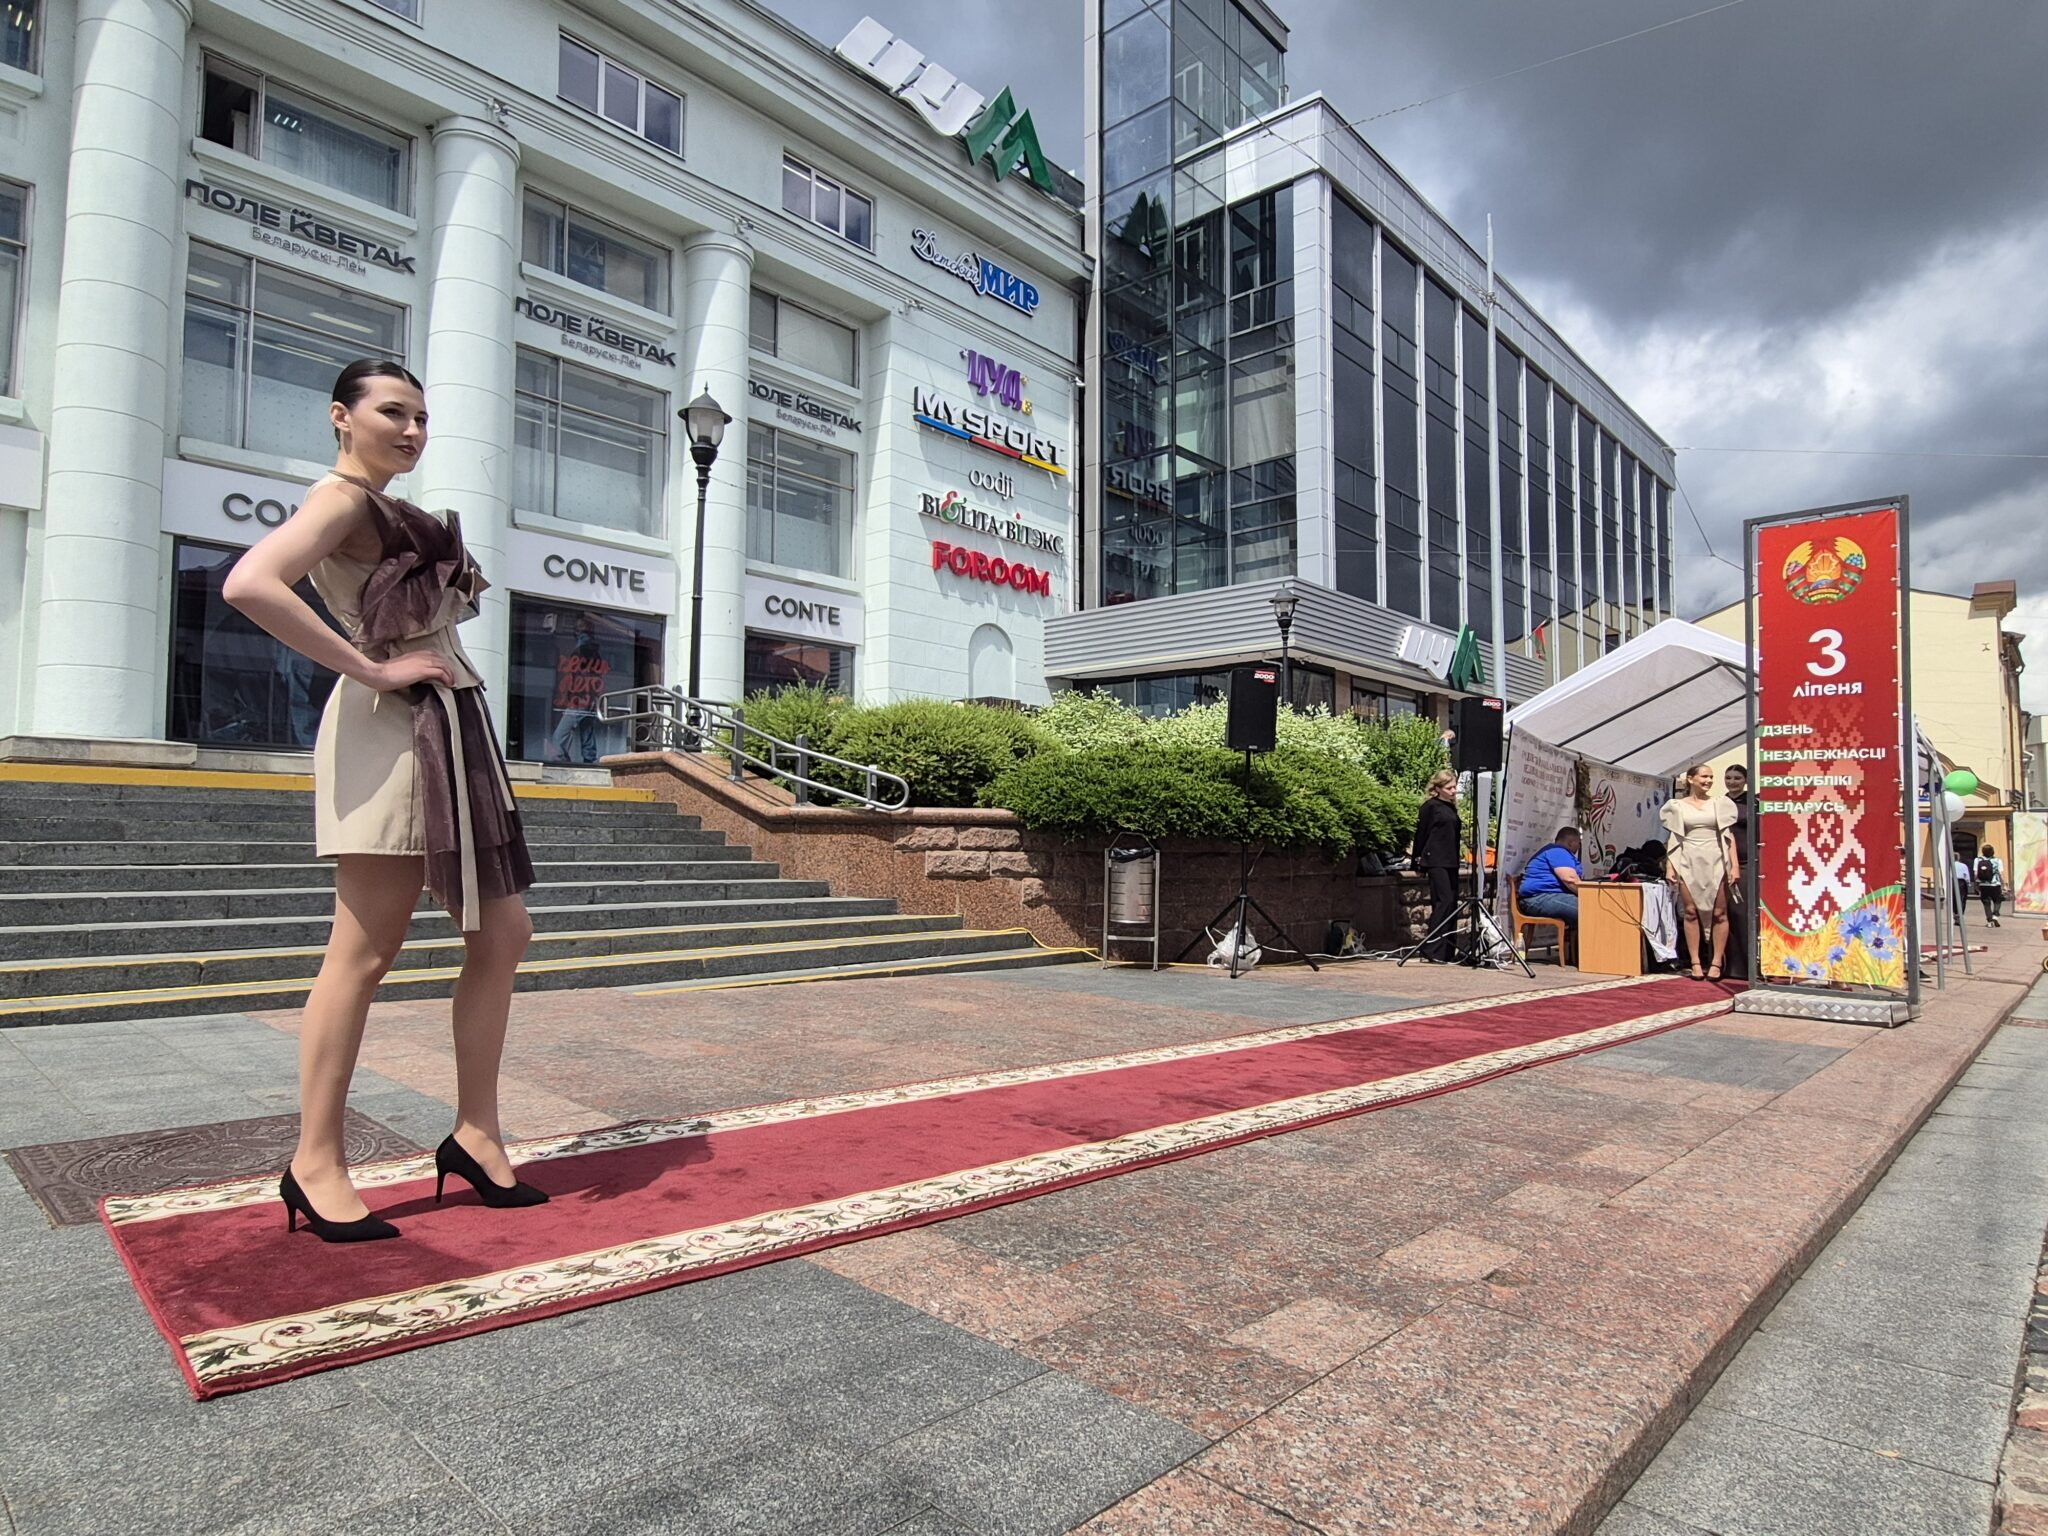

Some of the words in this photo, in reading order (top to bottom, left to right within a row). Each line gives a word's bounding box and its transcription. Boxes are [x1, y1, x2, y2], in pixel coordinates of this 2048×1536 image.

[836, 15, 1056, 195] ЦУМ
[185, 178, 281, 227] ПОЛЕ
[290, 210, 416, 274] КВЕТАК
[978, 255, 1040, 315] МИР
[515, 296, 582, 333] ПОЛЕ
[587, 316, 676, 367] КВЕТАК
[796, 393, 862, 433] КВЕТАК
[969, 469, 1015, 500] oodji
[222, 493, 299, 527] CO
[543, 554, 645, 592] CONTE
[932, 541, 1050, 597] FOROOM
[765, 595, 840, 625] CONTE
[1396, 624, 1485, 692] ЦУМ
[1806, 628, 1846, 677] 3
[1793, 681, 1862, 697] ліпеня
[1762, 724, 1813, 737] ДЗЕНЬ
[1763, 748, 1886, 760] НЕЗАЛЕЖНАСЦІ
[1763, 775, 1852, 787] РЭСПУБЛІКІ
[1763, 802, 1845, 813] БЕЛАРУСЬ
